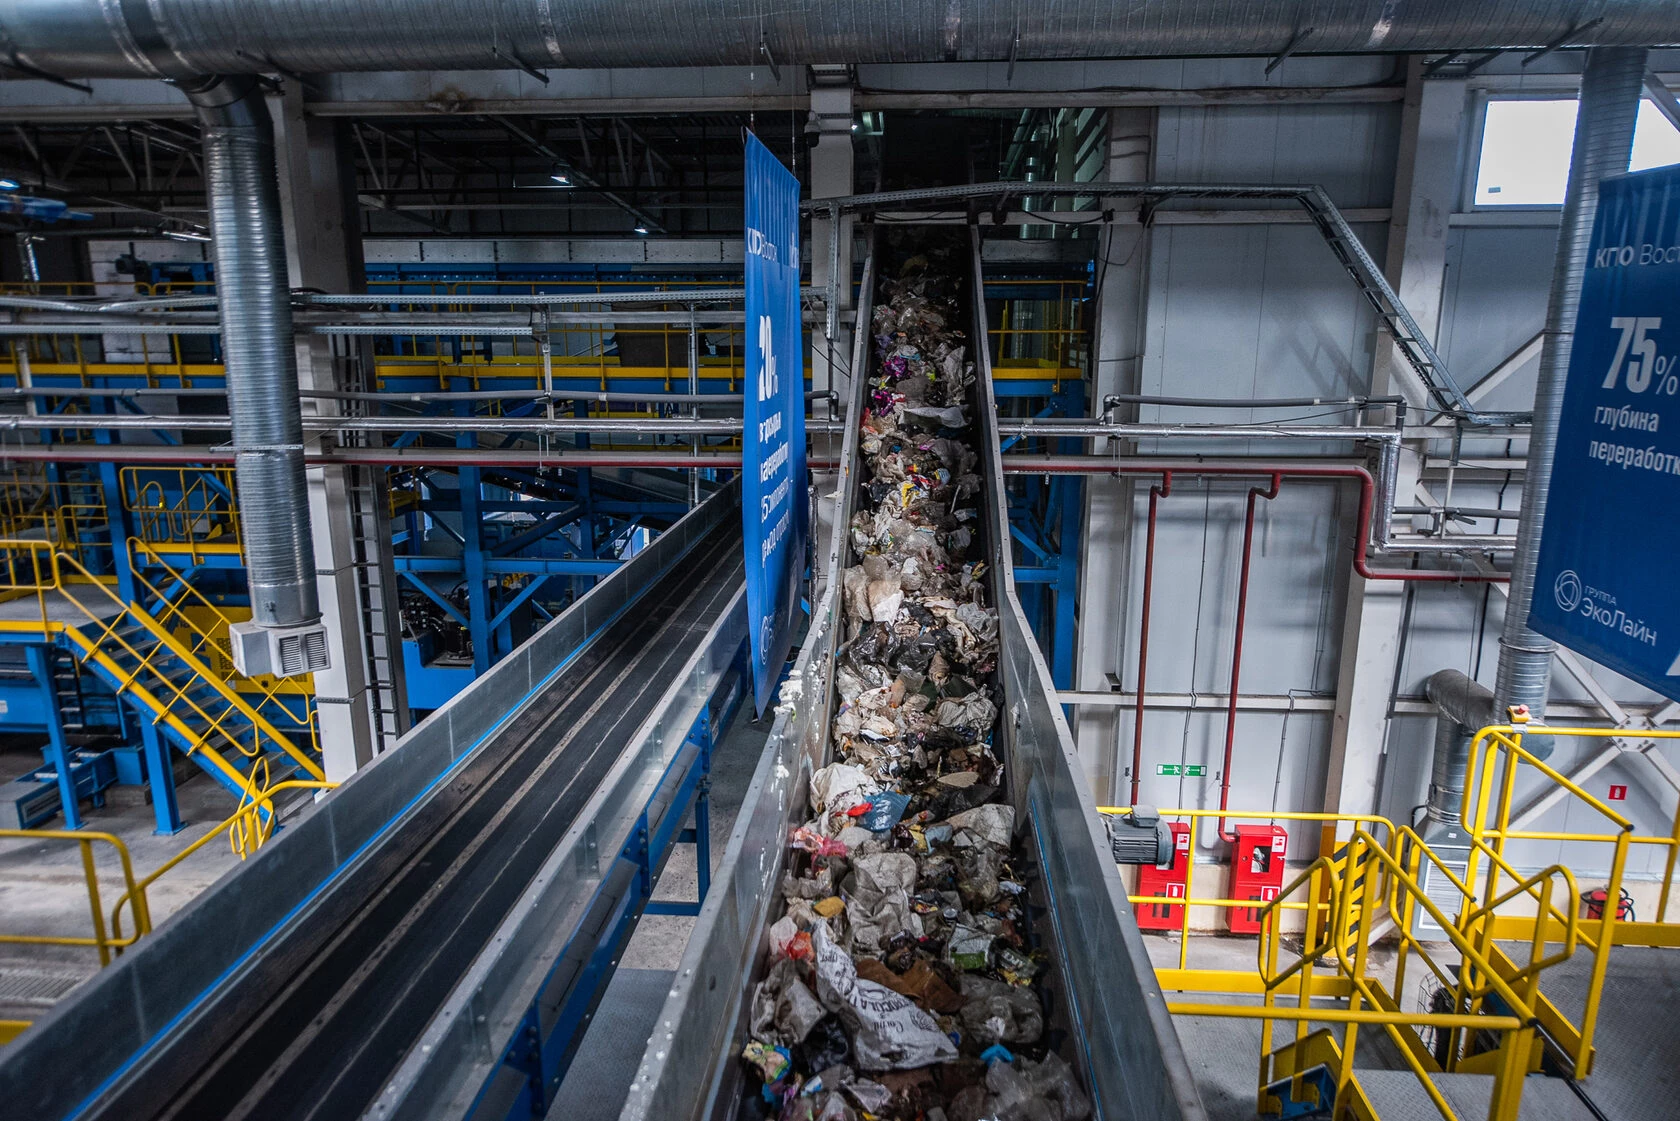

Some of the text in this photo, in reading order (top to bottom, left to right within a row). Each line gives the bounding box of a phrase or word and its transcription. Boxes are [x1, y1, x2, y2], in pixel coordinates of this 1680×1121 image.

[1594, 245, 1634, 268] КПО
[1601, 316, 1678, 395] 75%
[1594, 404, 1659, 432] глубина
[1584, 585, 1617, 606] ГРУППА
[1580, 597, 1657, 647] ЭкоЛайн
